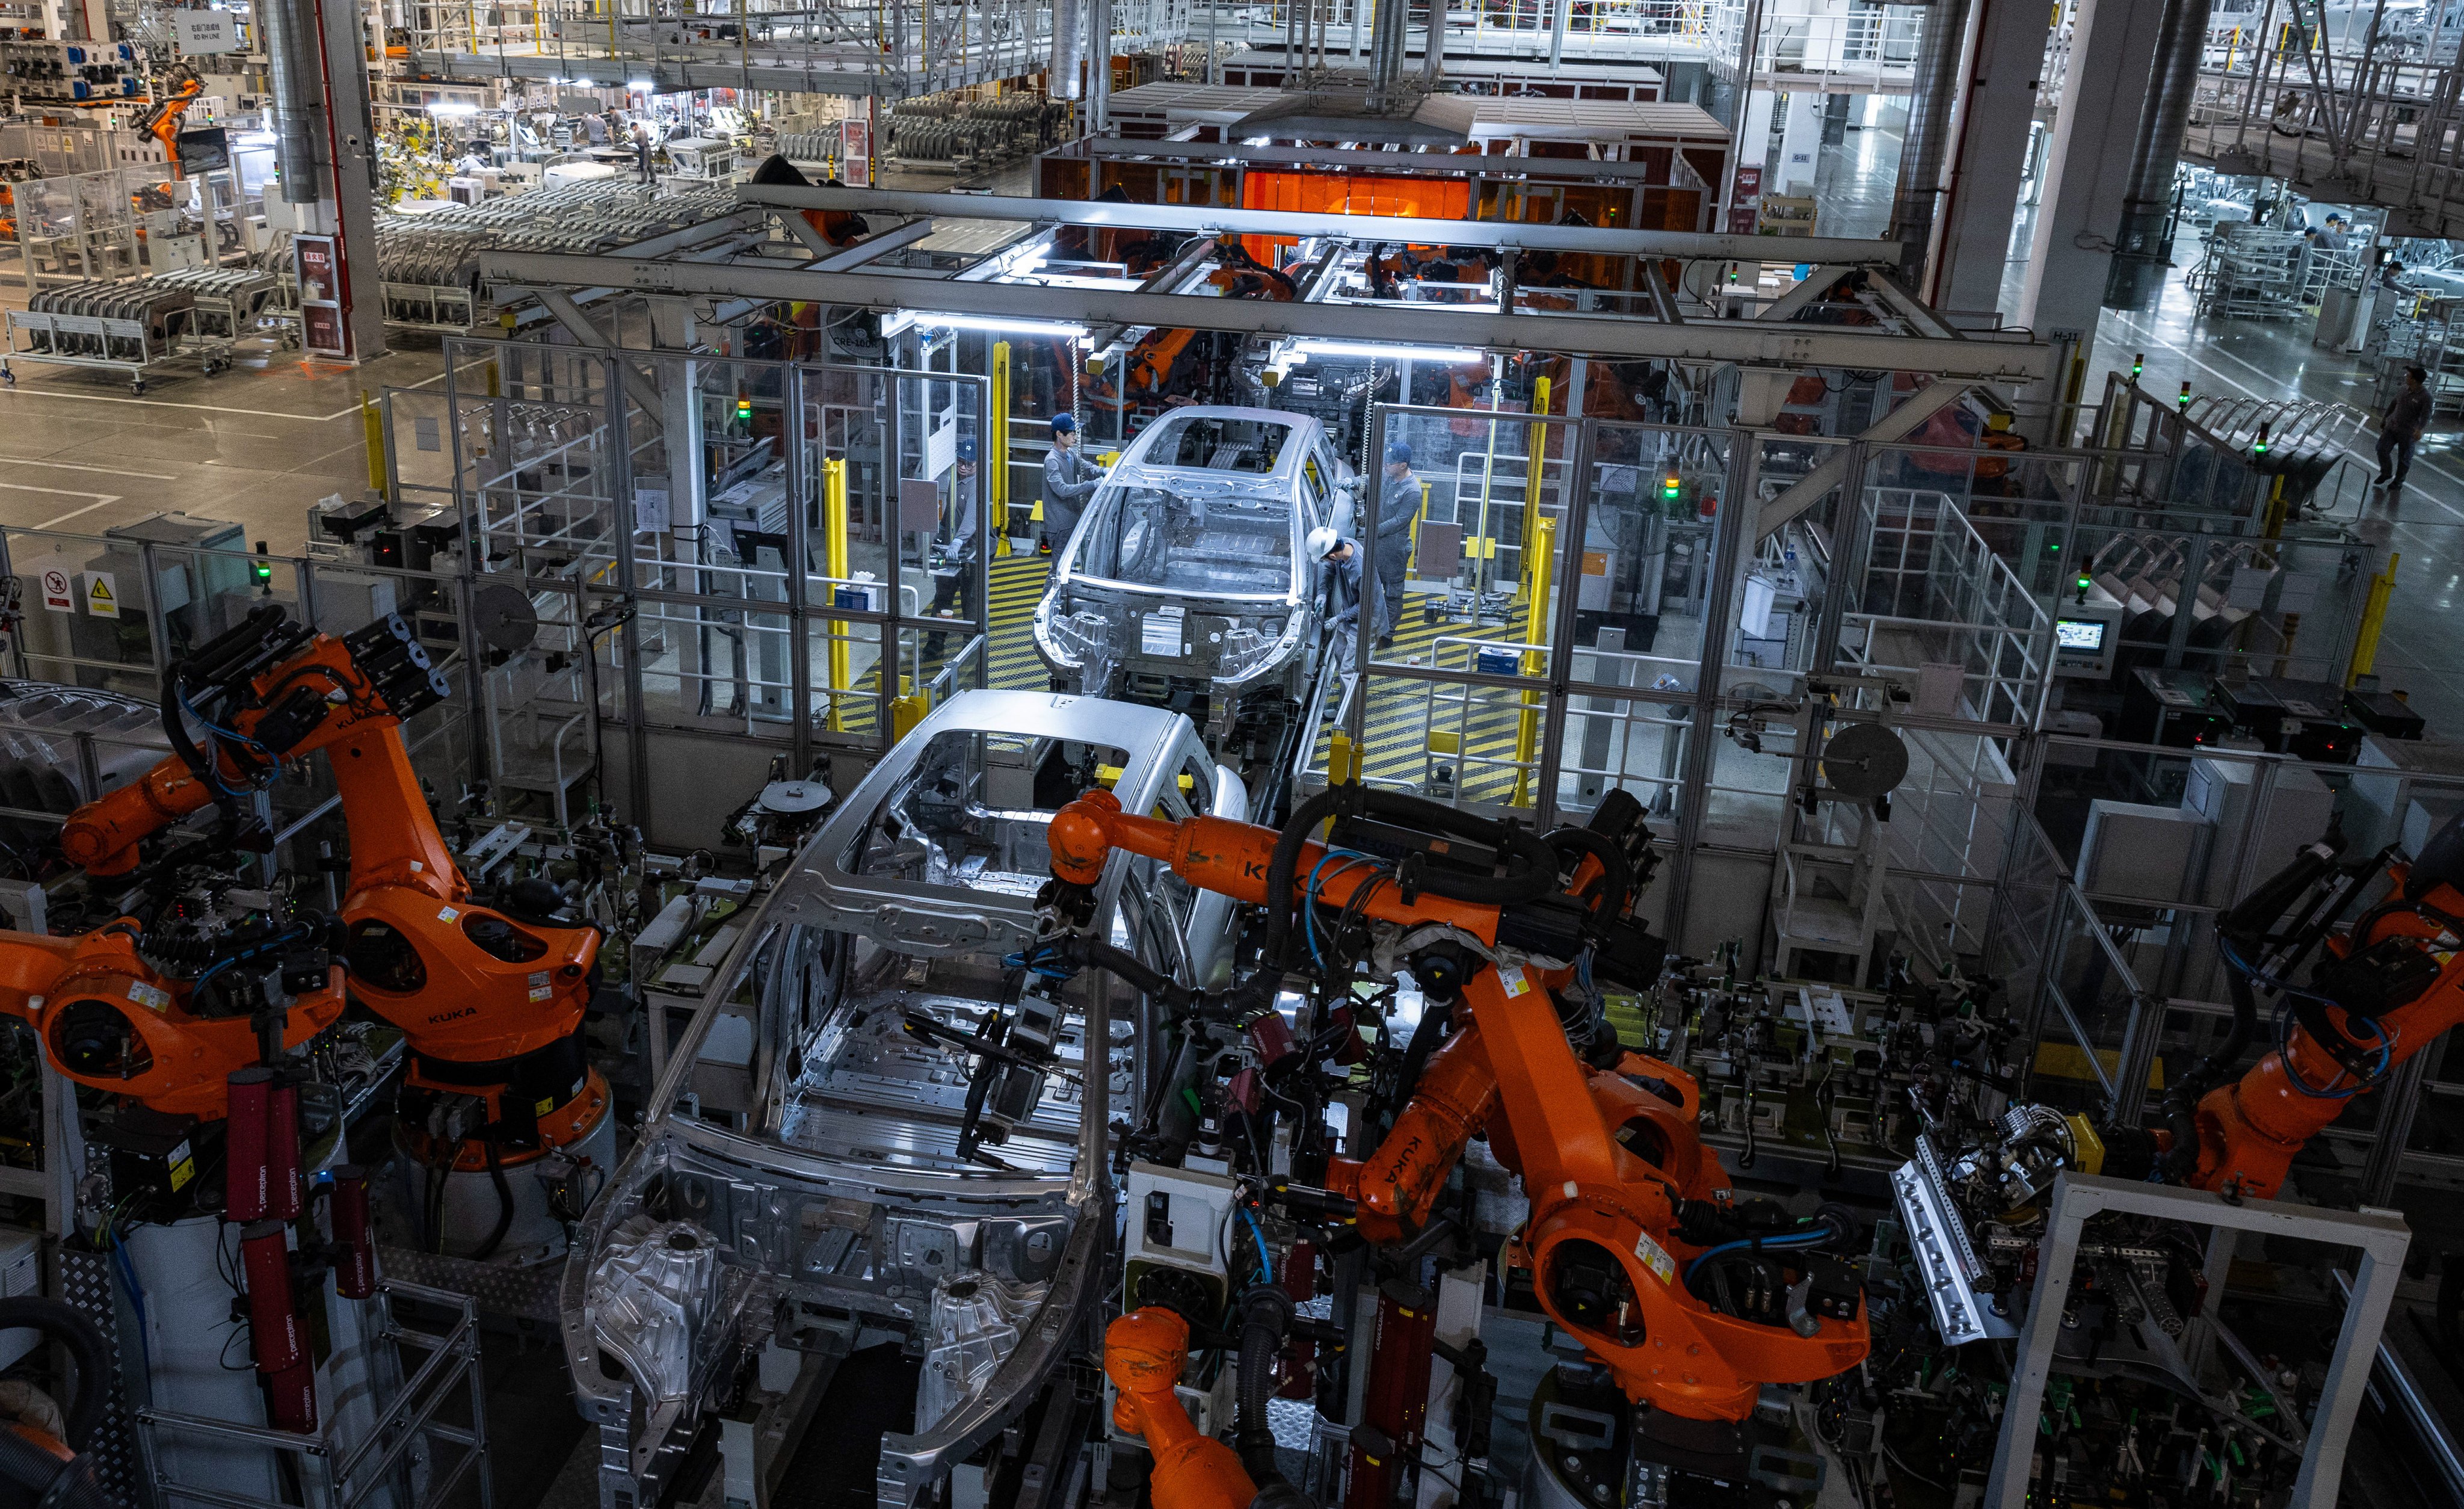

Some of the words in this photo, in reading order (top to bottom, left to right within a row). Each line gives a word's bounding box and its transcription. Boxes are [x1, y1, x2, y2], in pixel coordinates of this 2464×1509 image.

[2053, 331, 2077, 342] H-11
[428, 1007, 477, 1023] KUKA
[1385, 1136, 1422, 1183] KUKA
[259, 1165, 267, 1204] perceptron
[289, 1167, 298, 1205] perceptron
[286, 1314, 298, 1352] perceptron
[303, 1386, 313, 1421] perceptron
